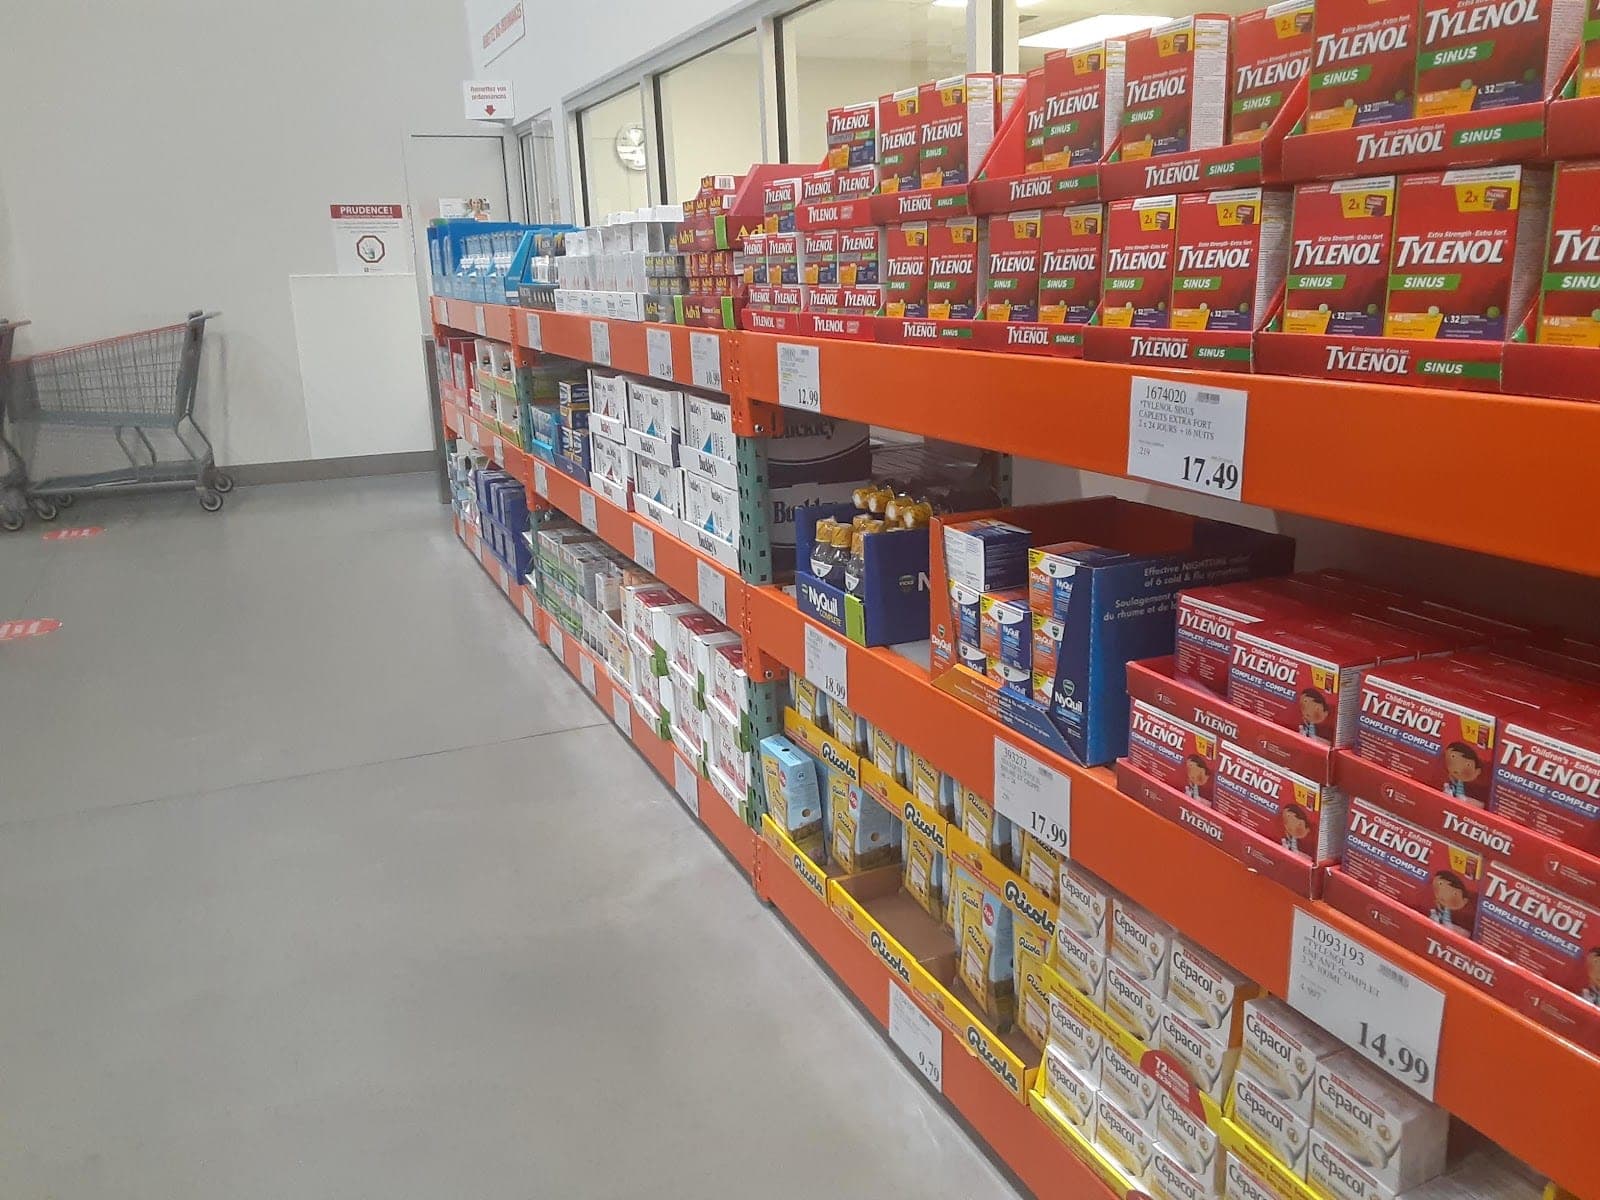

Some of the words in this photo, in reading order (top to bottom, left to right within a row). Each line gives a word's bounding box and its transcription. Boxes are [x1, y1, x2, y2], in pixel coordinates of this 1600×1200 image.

[1425, 0, 1539, 45] TYLENOL
[1315, 24, 1409, 67] TYLENOL
[1434, 46, 1478, 65] SINUS
[1322, 69, 1358, 86] SINUS
[1126, 75, 1186, 107] TYLENOL
[1046, 92, 1100, 121] TYLENOL
[1242, 96, 1271, 110] SINUS
[1131, 110, 1154, 122] SINUS
[921, 122, 963, 144] TYLENOL
[1050, 123, 1071, 135] SINUS
[1356, 131, 1443, 163] TYLENOL
[1460, 128, 1502, 143] SINUS
[838, 174, 870, 192] TYLENOL
[1145, 164, 1200, 188] TYLENOL
[1209, 163, 1234, 176] SINUS
[765, 187, 792, 203] TYLENOL
[804, 181, 831, 198] TYLENOL
[1464, 190, 1478, 203] 2x
[808, 206, 838, 223] TYLENOL
[806, 238, 833, 252] TYLENOL
[1428, 230, 1443, 238] Extra
[744, 242, 763, 255] TYLENOL
[769, 240, 793, 255] TYLENOL
[1179, 246, 1250, 271] TYLENOL
[1294, 240, 1380, 268] TYLENOL
[1397, 237, 1504, 268] TYLENOL
[888, 257, 924, 276] TYLENOL
[930, 257, 973, 276] TYLENOL
[990, 255, 1035, 274] TYLENOL
[1043, 252, 1095, 273] TYLENOL
[1109, 249, 1167, 272] TYLENOL
[994, 280, 1011, 288] SINUS
[1047, 279, 1067, 288] SINUS
[1113, 279, 1134, 288] SINUS
[1183, 279, 1210, 288] SINUS
[1299, 277, 1333, 287] SINUS
[1404, 277, 1445, 288] SINUS
[686, 305, 700, 319] Advil
[1450, 315, 1459, 324] 32
[1056, 335, 1075, 343] SINUS
[1131, 336, 1188, 358] TYLENOL
[1198, 349, 1225, 357] SINUS
[1326, 346, 1409, 373] TYLENOL
[1424, 362, 1463, 375] SINUS
[799, 388, 818, 406] 12.99
[1146, 386, 1186, 404] 1674020
[1182, 456, 1238, 490] 17.49
[1144, 565, 1179, 577] Effective
[1156, 577, 1163, 586] 6
[808, 586, 838, 615] NyQuil
[1115, 593, 1171, 609] Soulagement
[819, 609, 841, 626] COMPLETE
[1103, 612, 1115, 621] du
[1118, 607, 1144, 619] rhume
[932, 635, 951, 652] DayQuil
[1178, 628, 1204, 642] COMPLETE
[1232, 644, 1297, 685] TYLENOL
[1252, 648, 1275, 661] Children's
[826, 676, 845, 699] 18.99
[1232, 667, 1262, 685] COMPLETE
[1265, 682, 1296, 697] COMPLET
[1055, 694, 1083, 713] NyQuil
[1361, 689, 1441, 738] TYLENOL
[1385, 693, 1415, 709] Children's
[1420, 705, 1444, 719] Enfants
[1132, 711, 1184, 751] TYLENOL
[1360, 715, 1398, 736] COMPLETE
[1402, 731, 1441, 751] COMPLET
[1132, 731, 1156, 748] COMPLETE
[1159, 746, 1183, 761] COMPLET
[1531, 745, 1568, 764] Children's
[823, 743, 856, 781] Ricola
[1237, 758, 1259, 773] Children's
[1218, 752, 1280, 799] TYLENOL
[1217, 775, 1246, 794] COMPLETE
[1250, 792, 1279, 810] COMPLET
[1498, 769, 1547, 793] COMPLETE
[1551, 790, 1598, 813] COMPLET
[904, 803, 944, 849] Ricola
[1031, 811, 1067, 847] 17.99
[1350, 809, 1429, 864] TYLENOL
[1374, 815, 1404, 834] Children's
[1408, 831, 1432, 847] Enfants
[1443, 811, 1513, 856] TYLENOL
[1348, 834, 1386, 859] COMPLETE
[1389, 855, 1428, 878] COMPLET
[794, 855, 823, 896] Ricola
[1005, 881, 1055, 936] Ricola
[1486, 872, 1584, 939] TYLENOL
[1515, 882, 1551, 903] Children's
[1557, 901, 1586, 919] Enfants
[1483, 900, 1529, 930] COMPLETE
[1533, 927, 1580, 953] COMPLET
[870, 931, 910, 983] Ricola
[1019, 937, 1041, 955] Ricola
[1313, 926, 1365, 966] 1093193
[1427, 938, 1495, 987] TYLENOL
[967, 1026, 1018, 1092] Ricola
[1358, 1021, 1429, 1084] 14.99
[919, 1051, 939, 1082] 9.79
